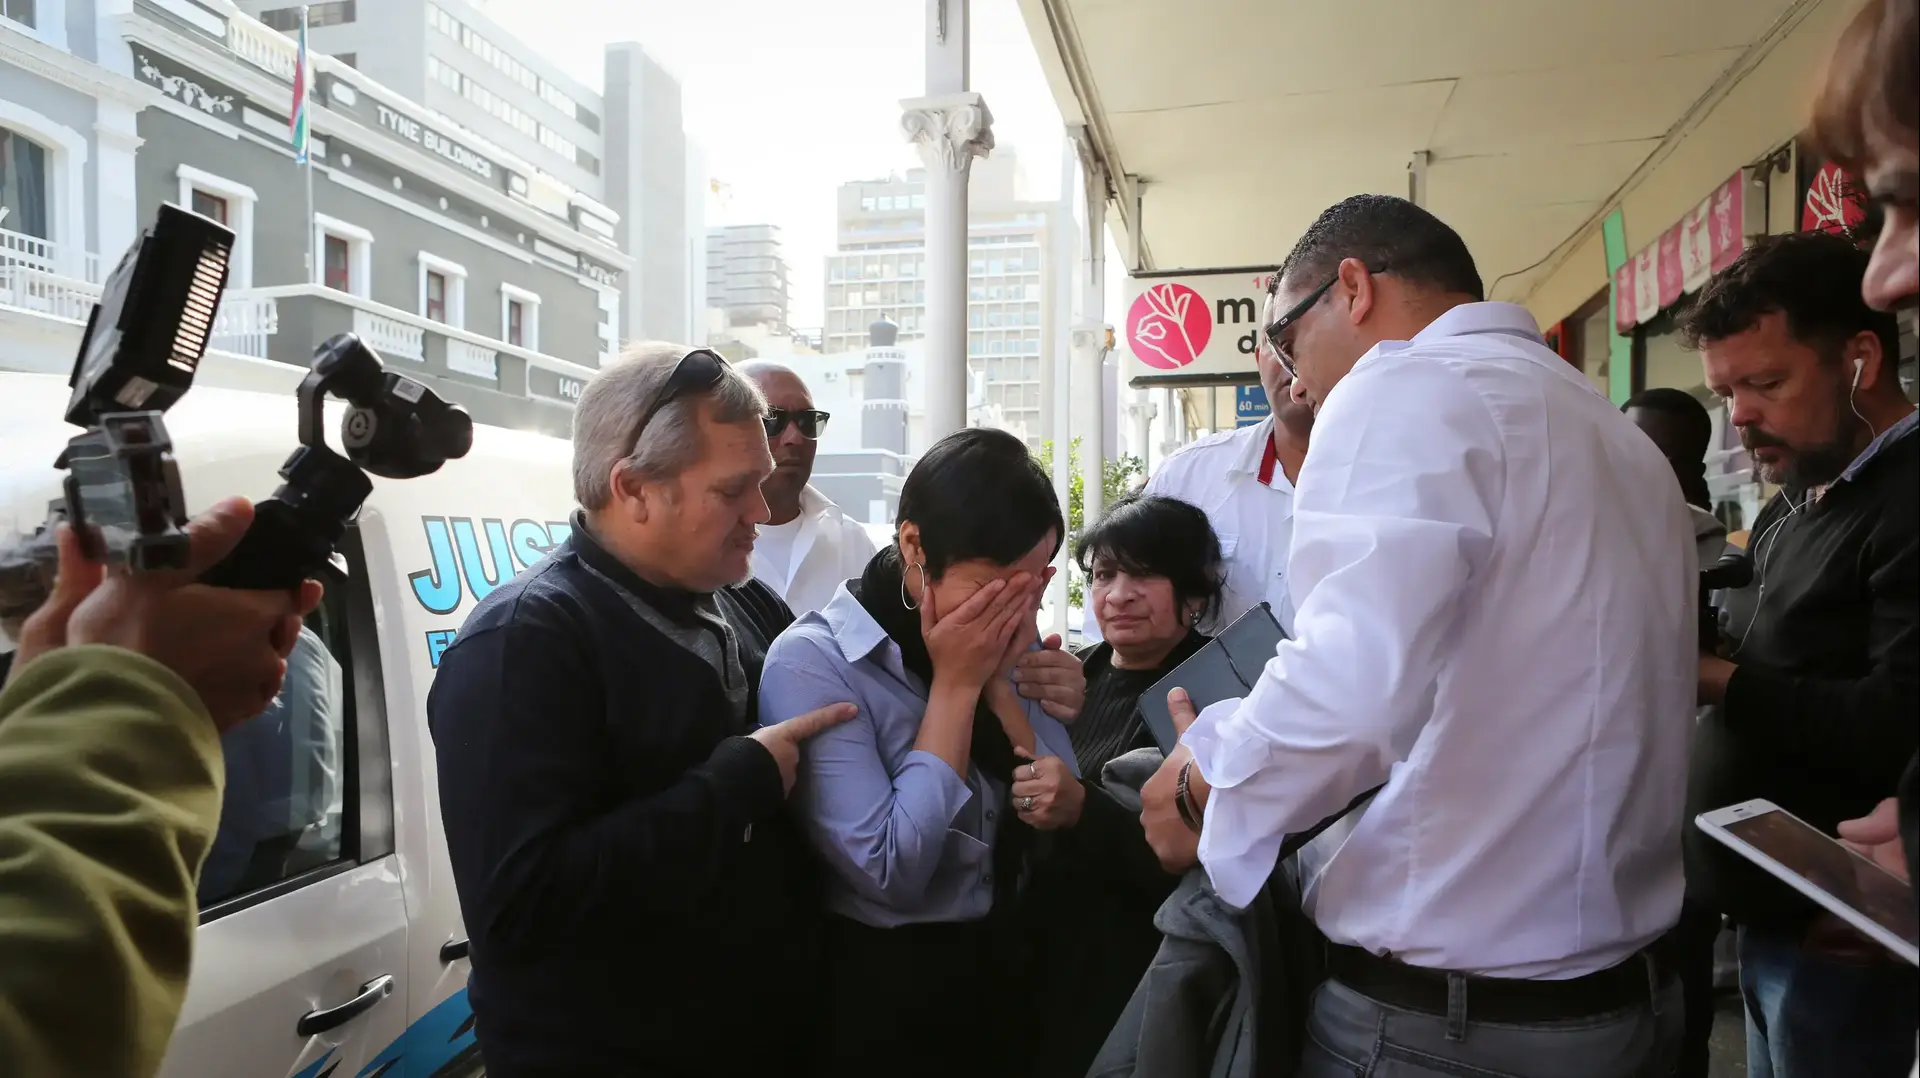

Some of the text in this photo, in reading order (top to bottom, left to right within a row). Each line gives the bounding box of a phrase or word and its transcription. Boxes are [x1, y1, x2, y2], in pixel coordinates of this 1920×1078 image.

[377, 105, 420, 143] TYNE
[559, 377, 580, 398] 140
[1239, 400, 1269, 411] 60 min
